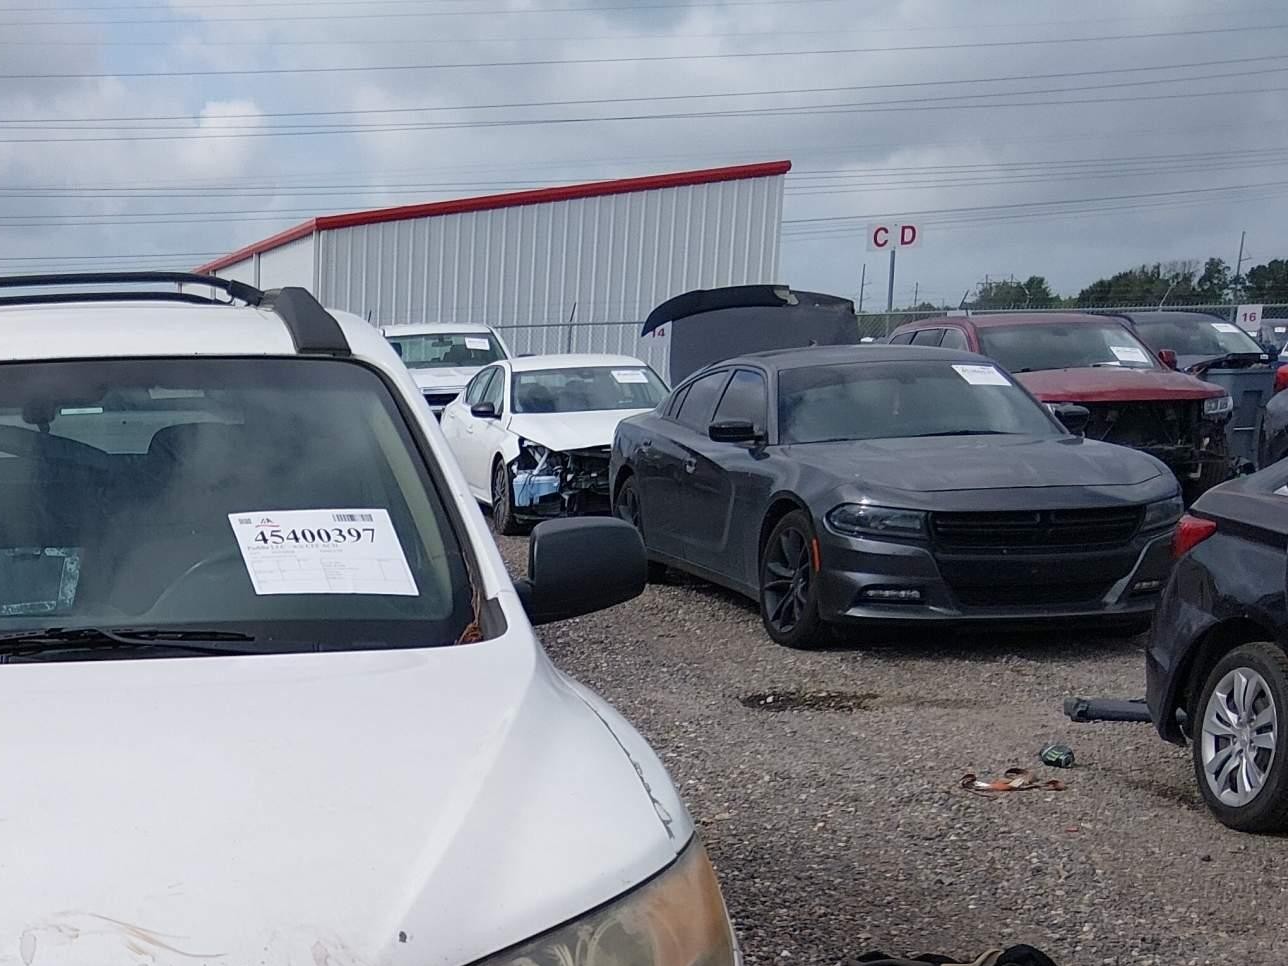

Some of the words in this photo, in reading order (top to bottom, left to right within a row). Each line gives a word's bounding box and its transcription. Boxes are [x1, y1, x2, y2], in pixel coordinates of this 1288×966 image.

[873, 226, 889, 248] C
[900, 225, 917, 246] D
[1242, 312, 1257, 322] 16
[254, 528, 376, 545] 45400397
